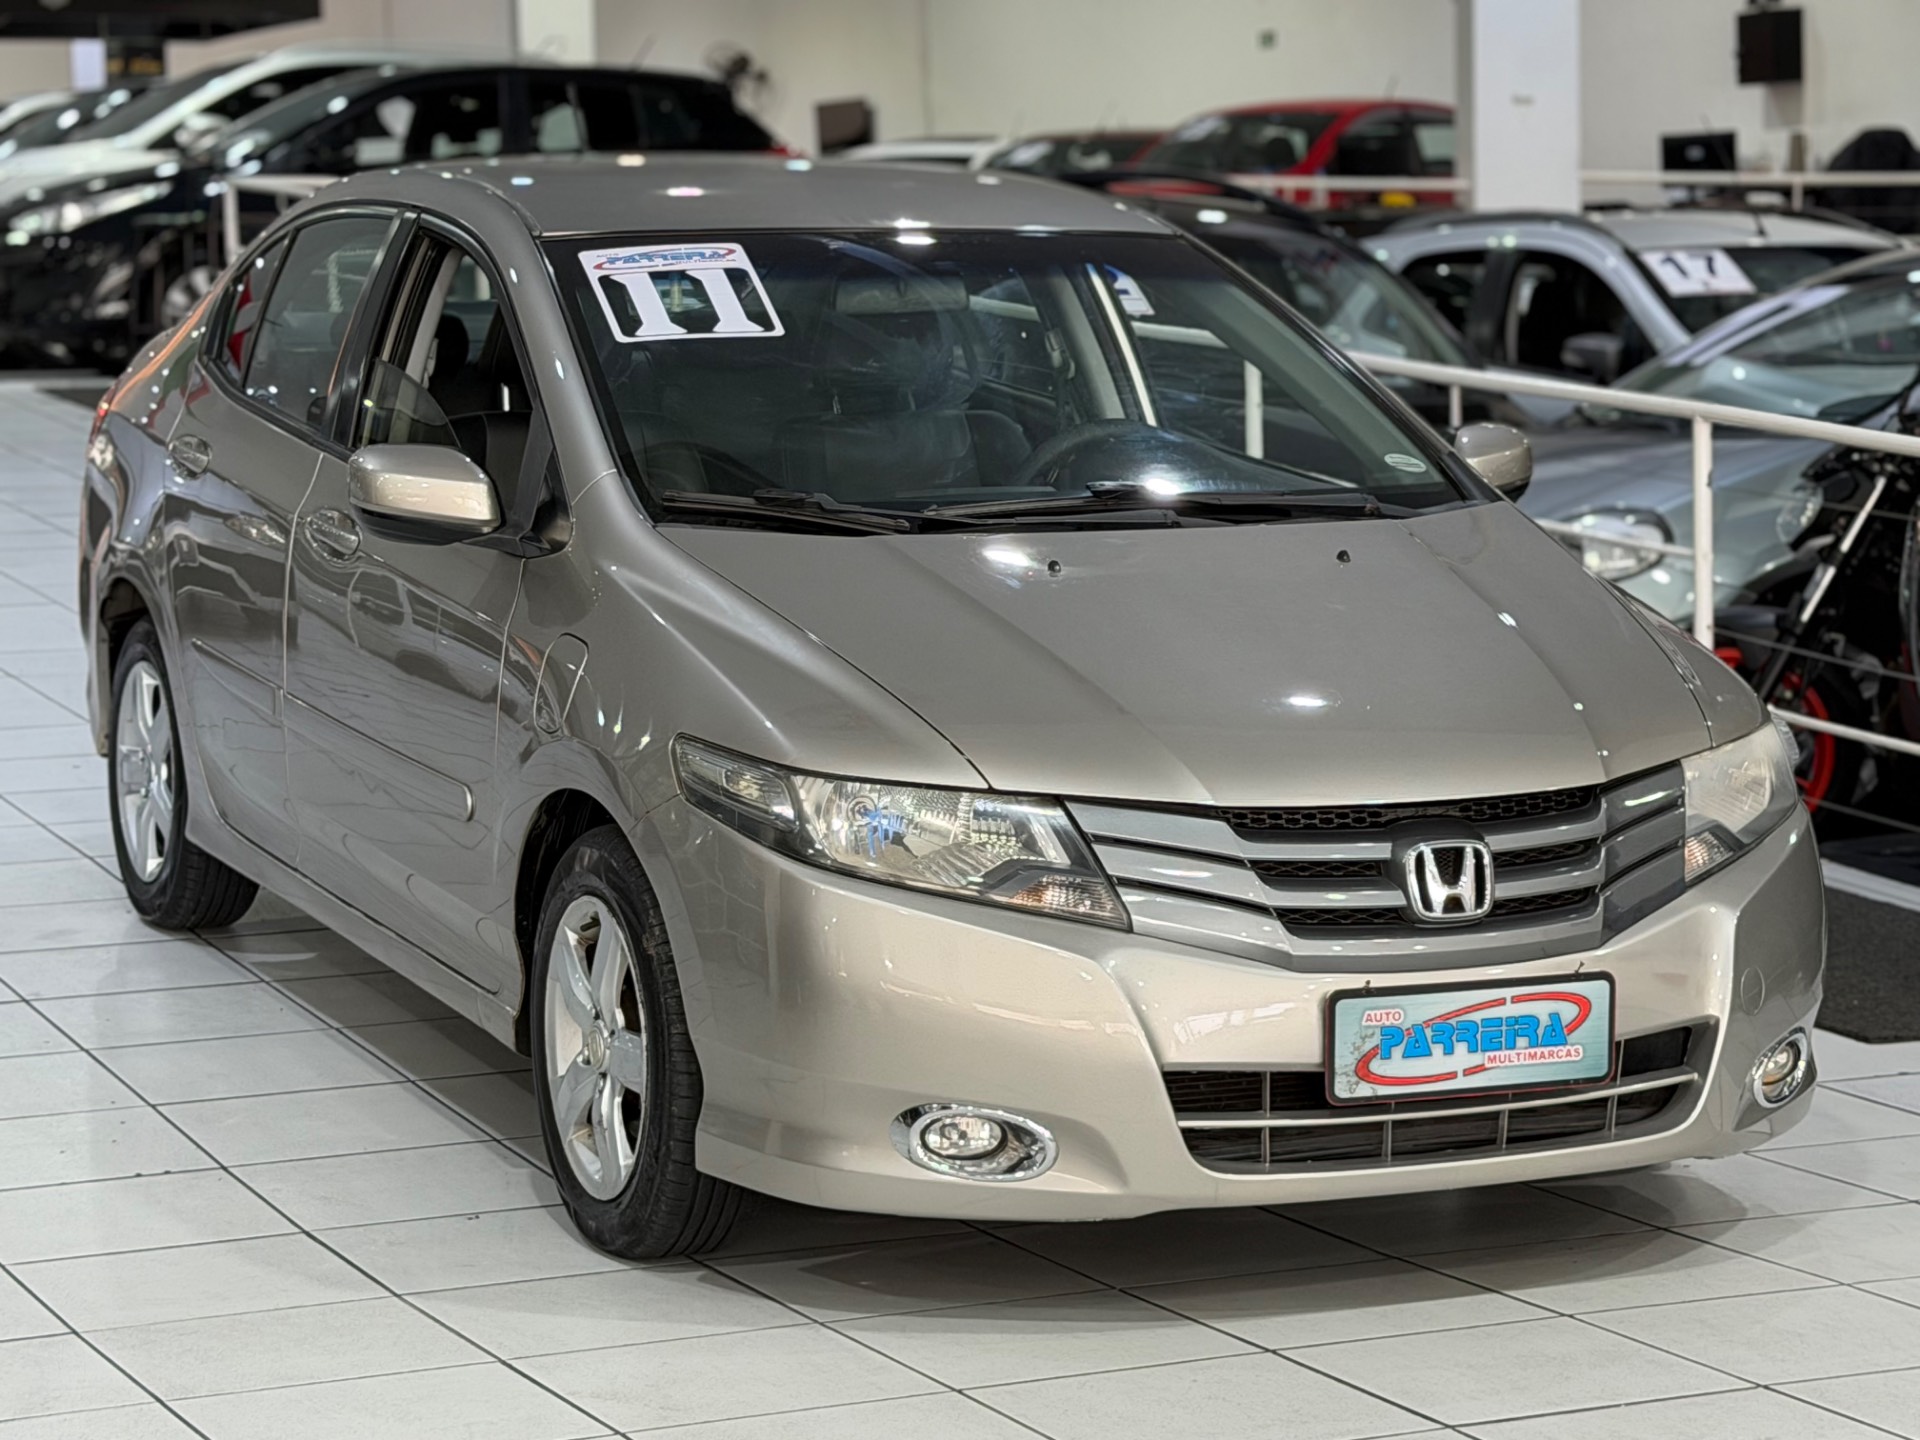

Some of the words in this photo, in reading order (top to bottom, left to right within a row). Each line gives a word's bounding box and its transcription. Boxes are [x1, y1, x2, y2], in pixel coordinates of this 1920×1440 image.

[609, 268, 766, 337] 11
[1364, 1010, 1402, 1024] AUTO
[1379, 1012, 1569, 1060] PARREIRA
[1486, 1046, 1582, 1066] MULTIMARCAS
